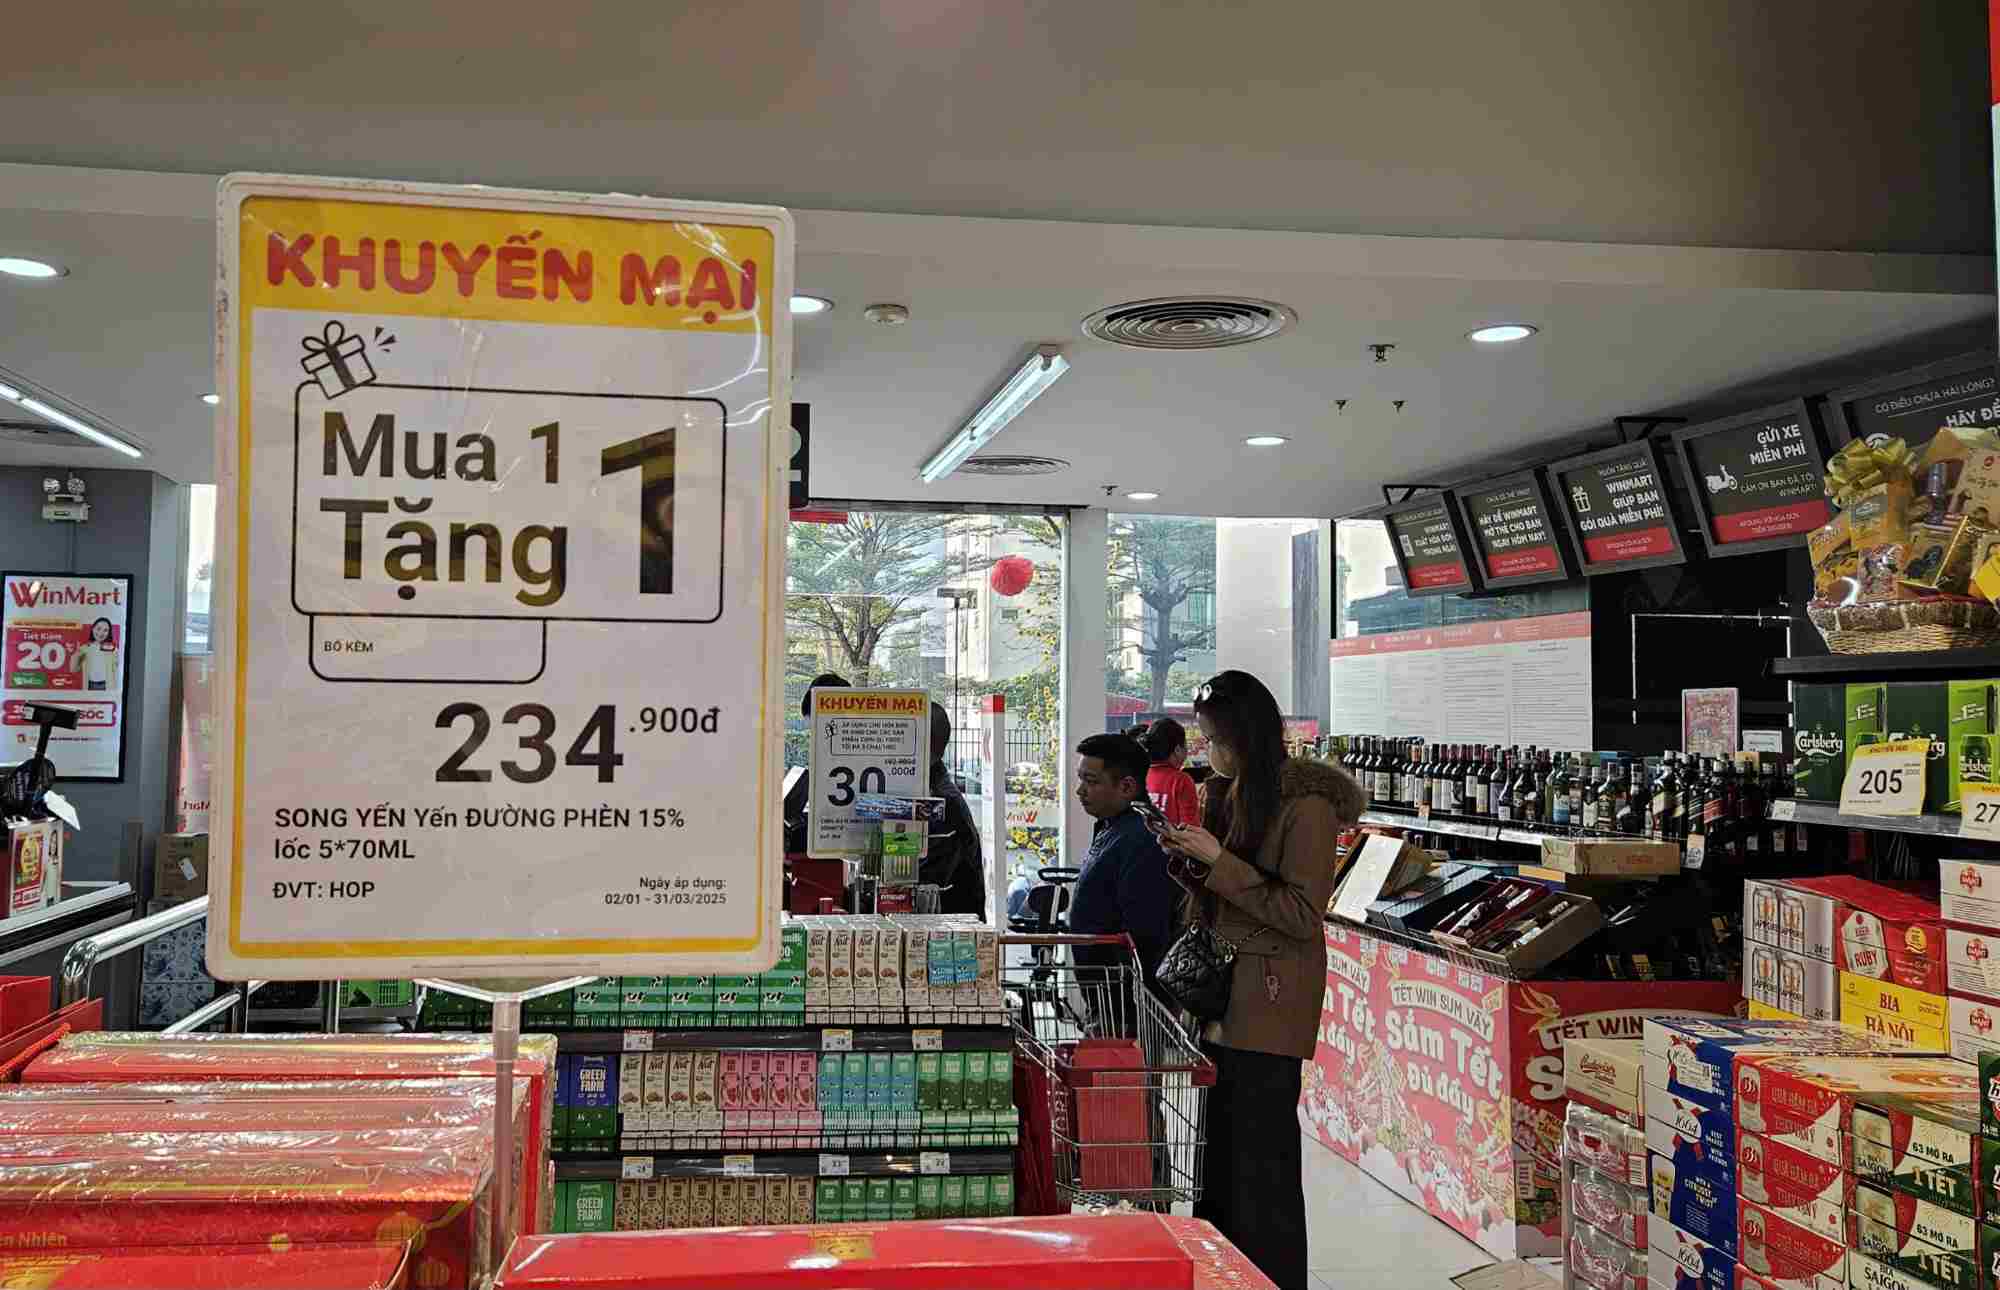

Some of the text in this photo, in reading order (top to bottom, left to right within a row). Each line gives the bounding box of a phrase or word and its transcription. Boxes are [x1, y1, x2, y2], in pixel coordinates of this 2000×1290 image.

[267, 231, 758, 324] KHUYẾN MẠI
[1946, 410, 1977, 427] HÃY
[1757, 424, 1801, 444] GỬI XE
[322, 411, 561, 484] Mua 1
[1749, 440, 1806, 465] MIỄN PHÍ
[1606, 474, 1653, 493] WINMART
[601, 427, 677, 595] 1
[320, 496, 568, 607] Tặng
[8, 580, 121, 608] WinMart
[820, 692, 922, 713] KHUYẾN MẠI
[435, 702, 720, 783] 234 .900đ
[1795, 730, 1843, 753] Carlsberg
[828, 766, 886, 806] 30
[1859, 769, 1903, 794] 205
[275, 802, 685, 828] SONG YẾN Yến ĐƯỜNG PHÈN 15%
[273, 881, 375, 899] ĐVT: HOP
[639, 876, 727, 889] Ngày áp dụng:
[604, 893, 641, 905] 02/01
[654, 892, 727, 905] 31/03/2025
[1855, 951, 1878, 968] RUBY
[1416, 987, 1438, 1009] WIN
[1440, 994, 1463, 1018] SUM
[1879, 991, 1900, 1013] BIA
[1546, 1016, 1643, 1044] TẾT WIN
[1865, 1014, 1886, 1036] HÀ
[580, 1068, 606, 1080] GREEN
[1450, 1026, 1504, 1102] Tết
[581, 1080, 604, 1092] FARM
[1912, 1142, 1924, 1154] 63
[1912, 1166, 1958, 1199] 1 TẾT
[576, 1197, 603, 1208] GREEN
[577, 1208, 601, 1221] FARM
[1917, 1224, 1928, 1236] 63
[1917, 1249, 1962, 1285] 1 TẾT
